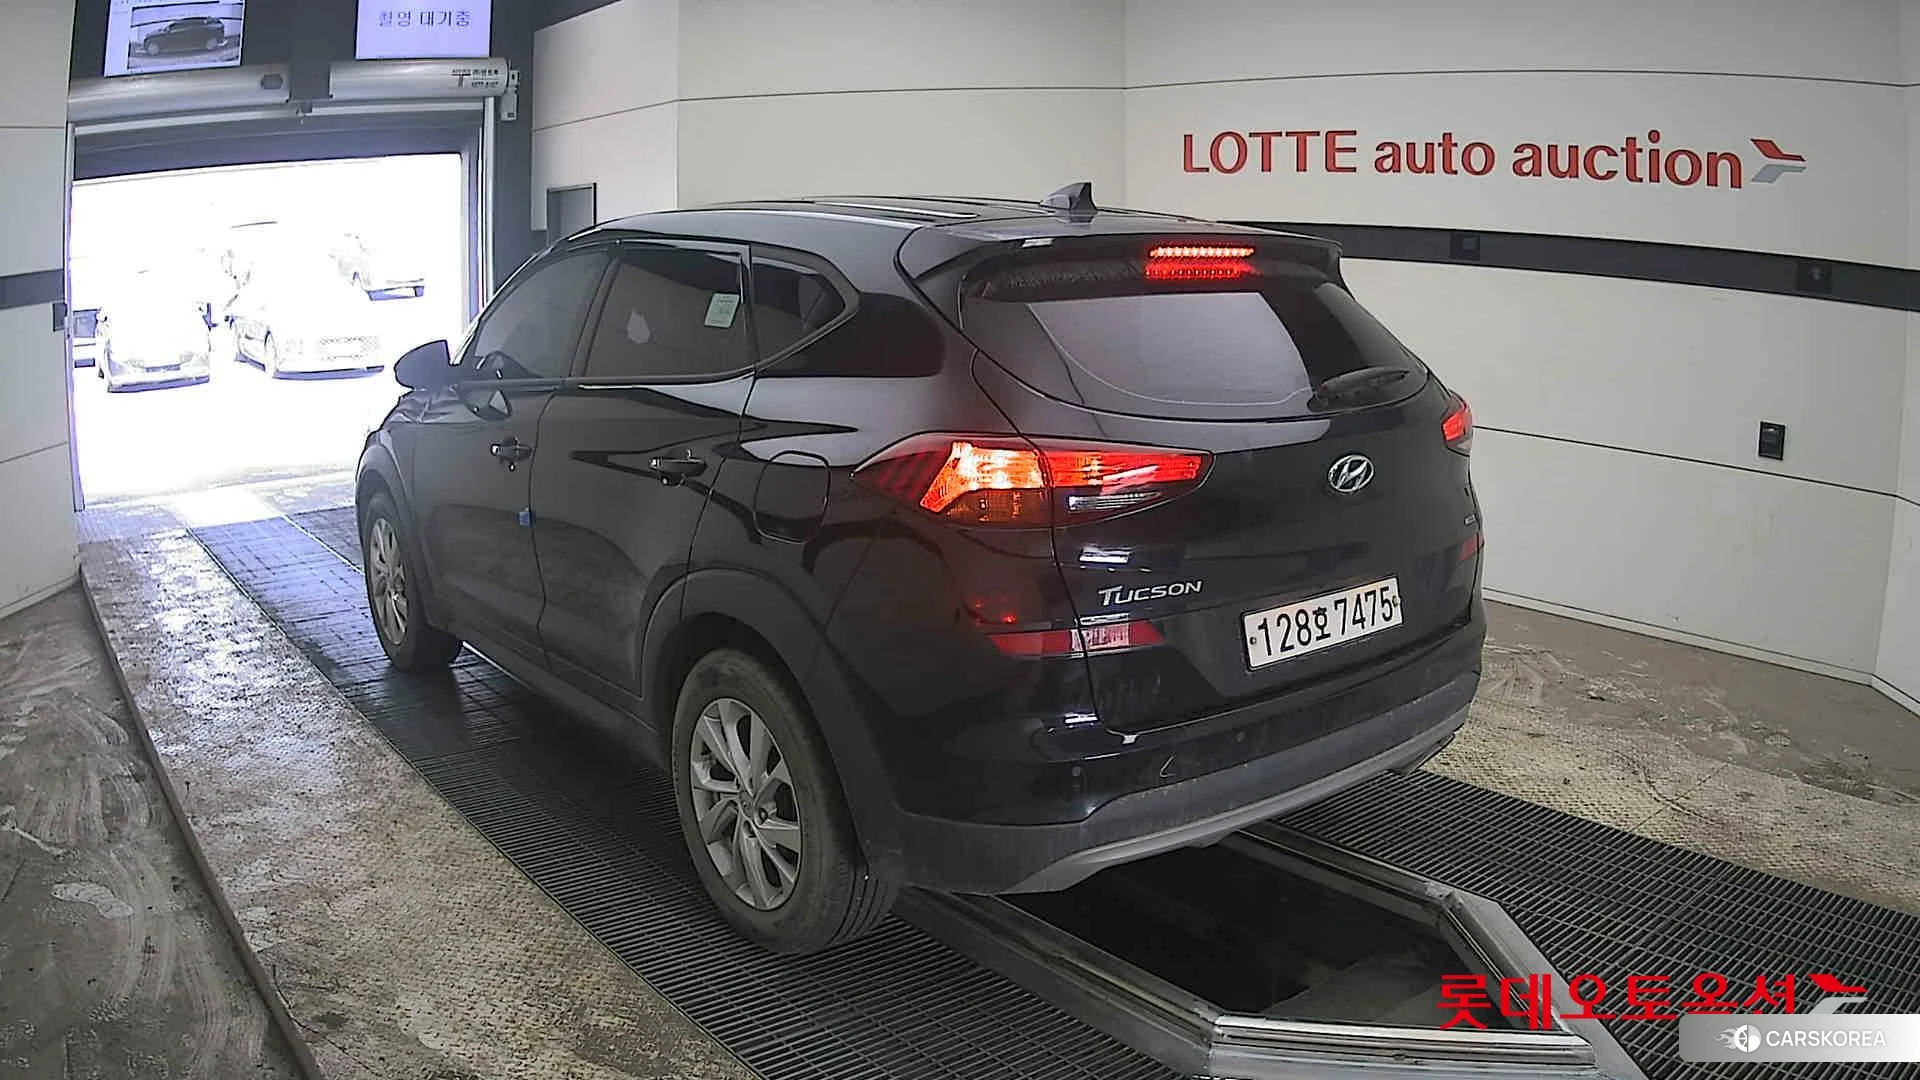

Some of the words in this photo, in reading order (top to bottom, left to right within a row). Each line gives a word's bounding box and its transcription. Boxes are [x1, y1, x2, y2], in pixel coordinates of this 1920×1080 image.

[420, 9, 472, 28] 대기중
[1183, 130, 1358, 175] LOTTE
[1374, 131, 1496, 177] auto
[1512, 129, 1744, 190] auction
[1098, 580, 1204, 606] TUCSON
[1258, 605, 1332, 657] 128호
[1334, 586, 1394, 636] 7475
